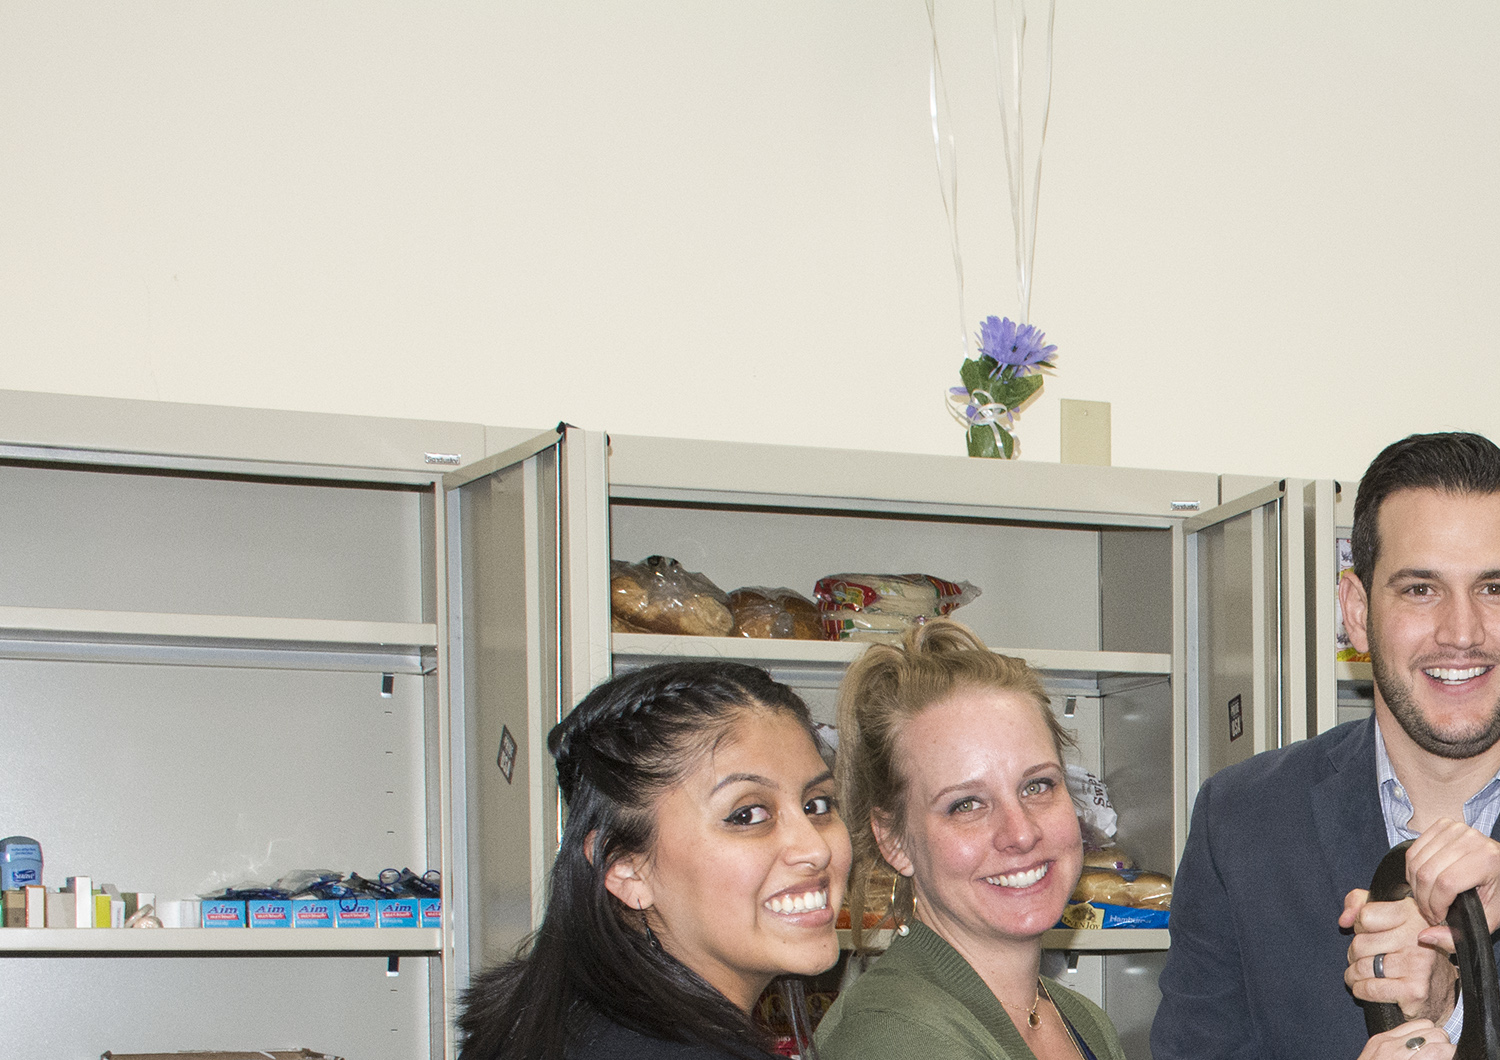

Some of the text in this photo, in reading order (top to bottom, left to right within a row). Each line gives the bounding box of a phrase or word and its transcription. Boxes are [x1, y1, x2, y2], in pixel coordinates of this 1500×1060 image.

[207, 905, 238, 914] Aim
[255, 904, 285, 913] Aim
[298, 904, 328, 913] Aim
[383, 903, 412, 912] Aim
